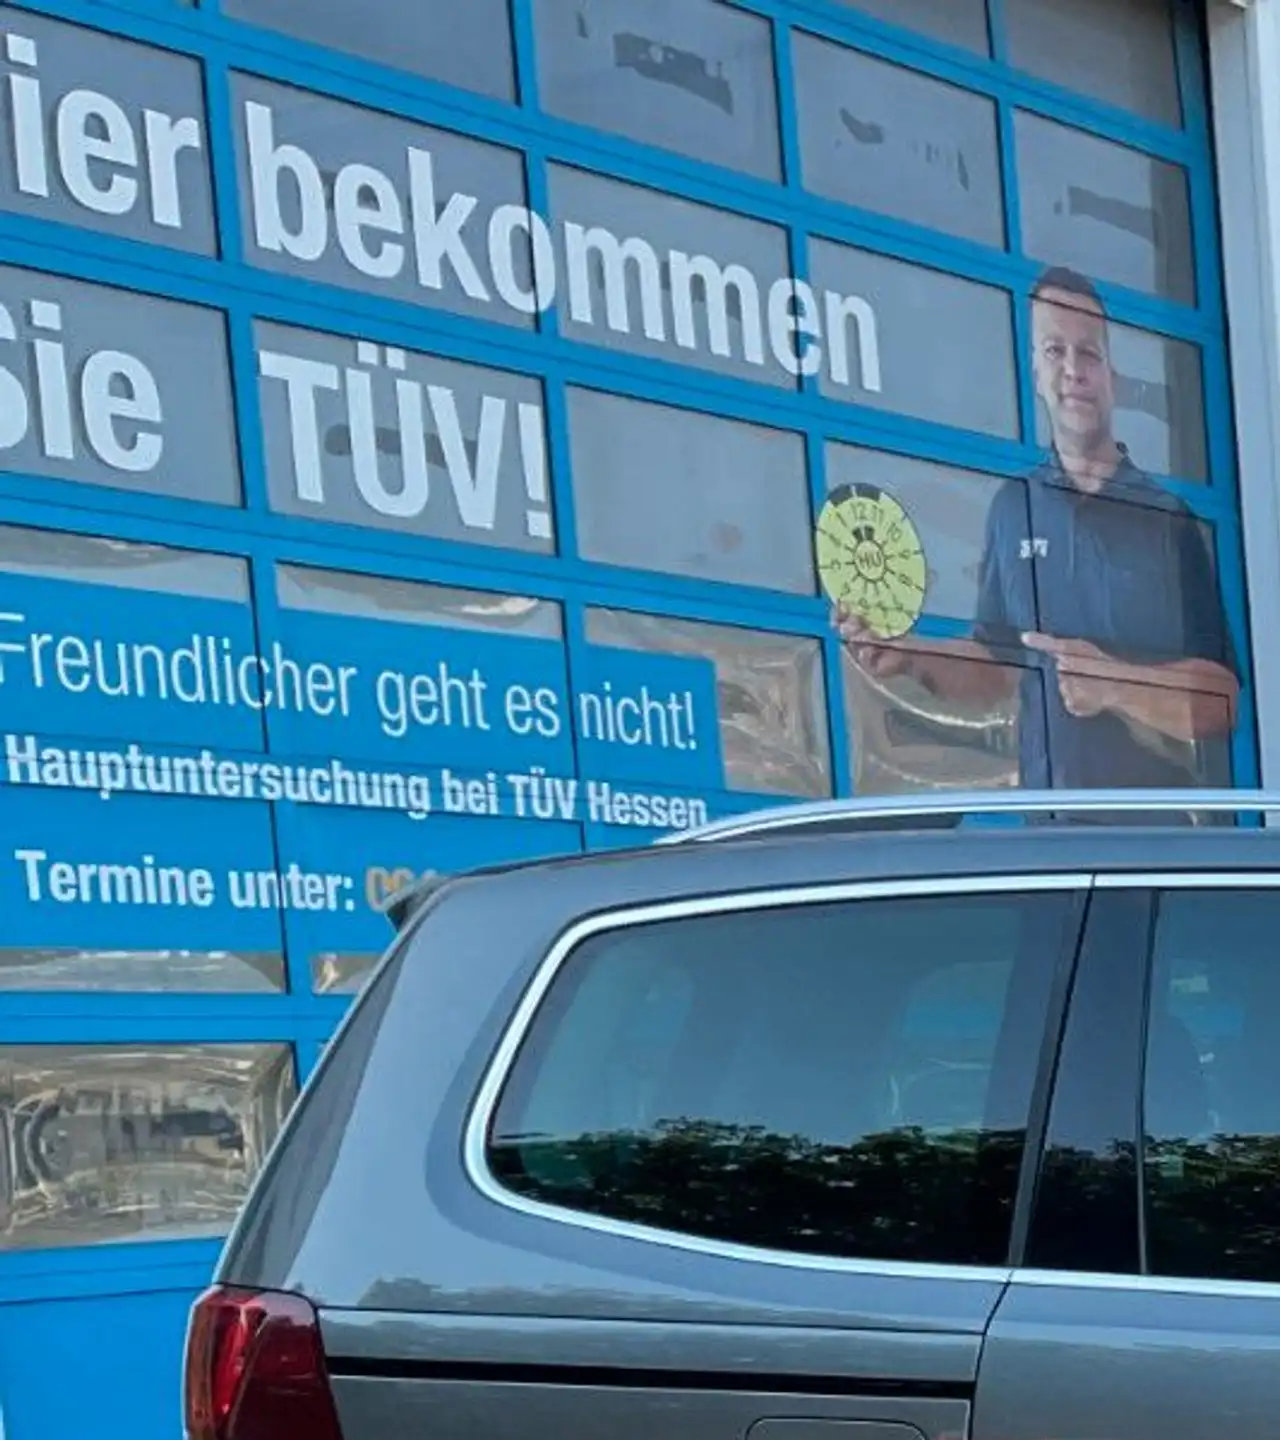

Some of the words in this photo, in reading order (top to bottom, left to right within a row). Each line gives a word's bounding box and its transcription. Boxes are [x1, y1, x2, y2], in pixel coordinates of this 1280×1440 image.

[245, 101, 882, 393] bekommen
[258, 341, 552, 539] TÜV!
[0, 612, 357, 717] Freundlicher
[377, 661, 491, 738] geht
[505, 683, 561, 738] es
[580, 681, 697, 750] nicht!
[4, 735, 430, 819] Hauptuntersuchung
[443, 769, 498, 815] bei
[507, 767, 576, 821] TÜV
[587, 781, 708, 831] Hessen
[15, 849, 214, 908] Termine
[229, 864, 355, 911] unter:
